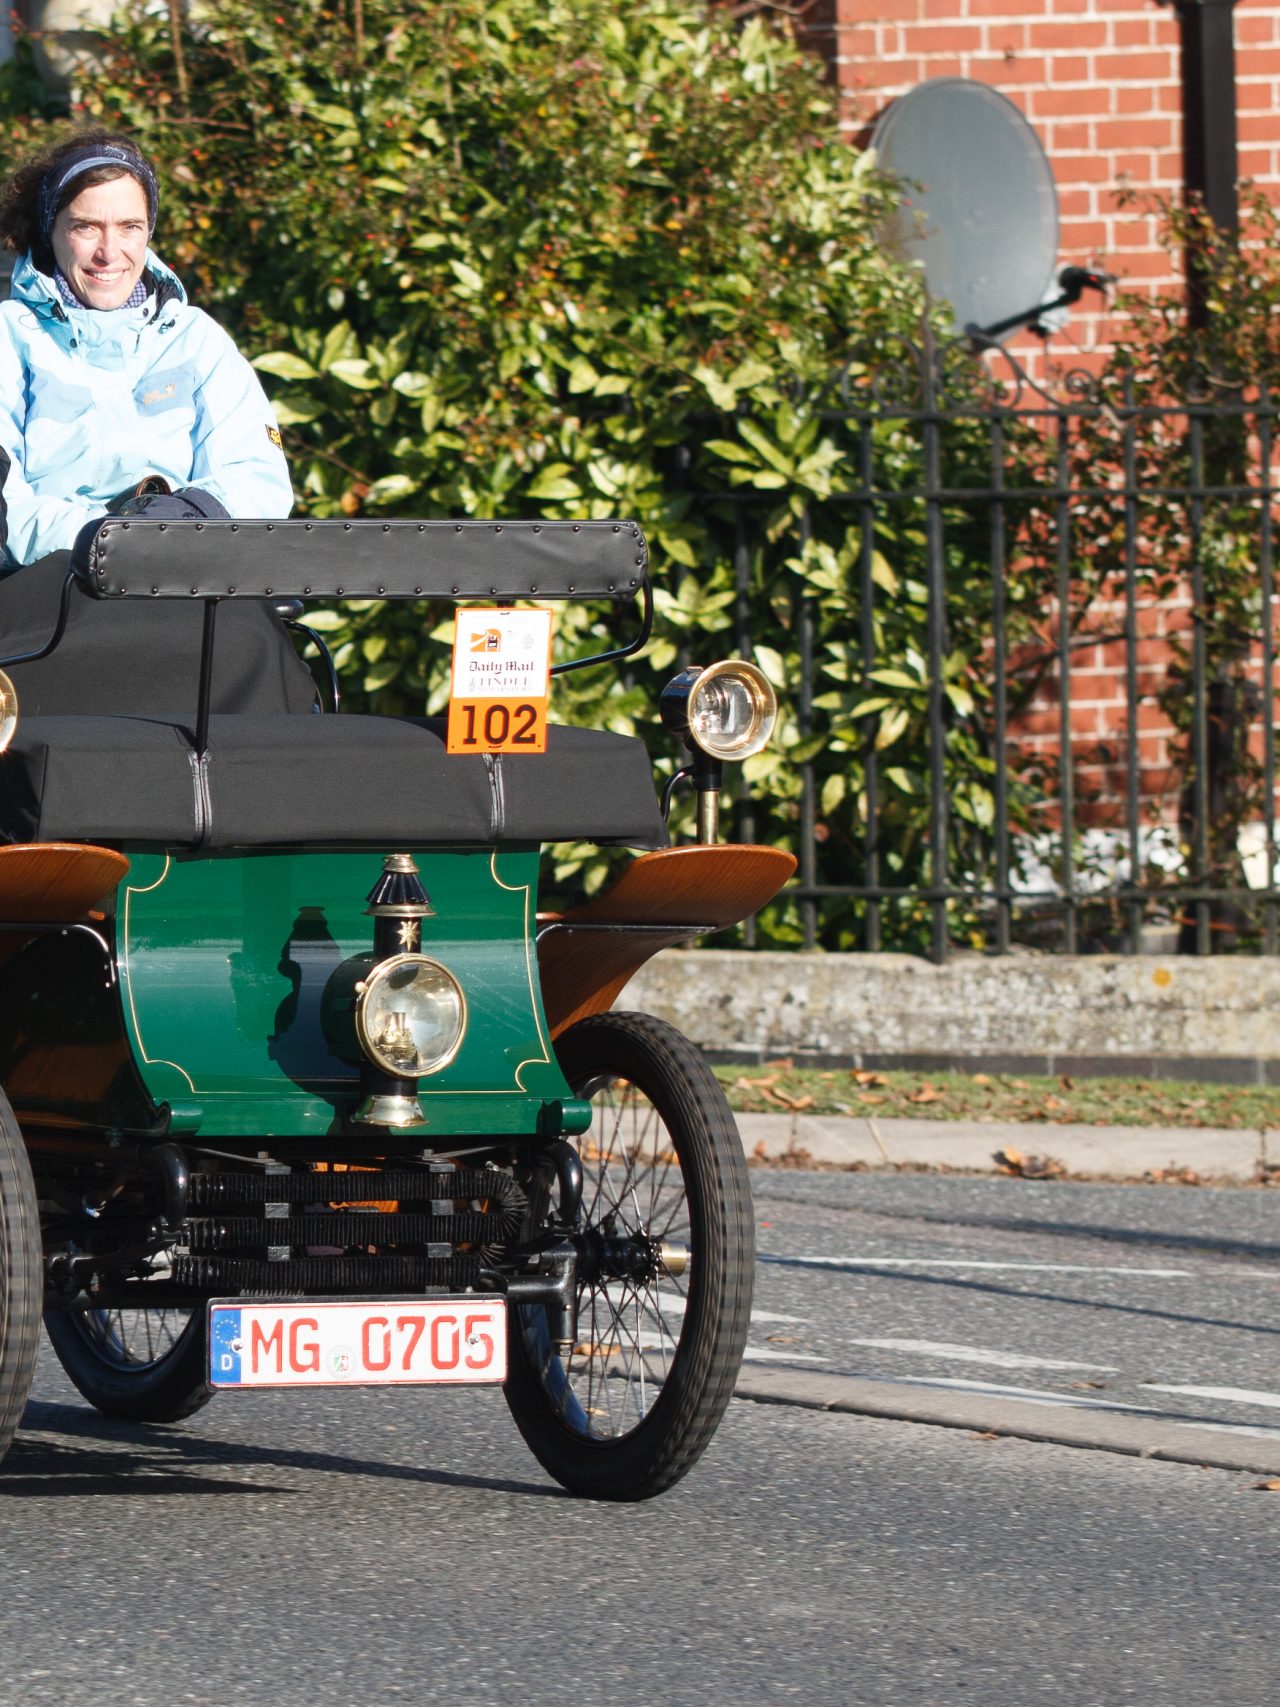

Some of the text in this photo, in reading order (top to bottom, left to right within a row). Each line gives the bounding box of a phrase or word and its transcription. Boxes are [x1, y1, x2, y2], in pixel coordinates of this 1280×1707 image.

[469, 661, 534, 674] Daily Mail
[462, 704, 537, 745] 102
[251, 1315, 494, 1373] MG 0705
[221, 1354, 232, 1370] D
